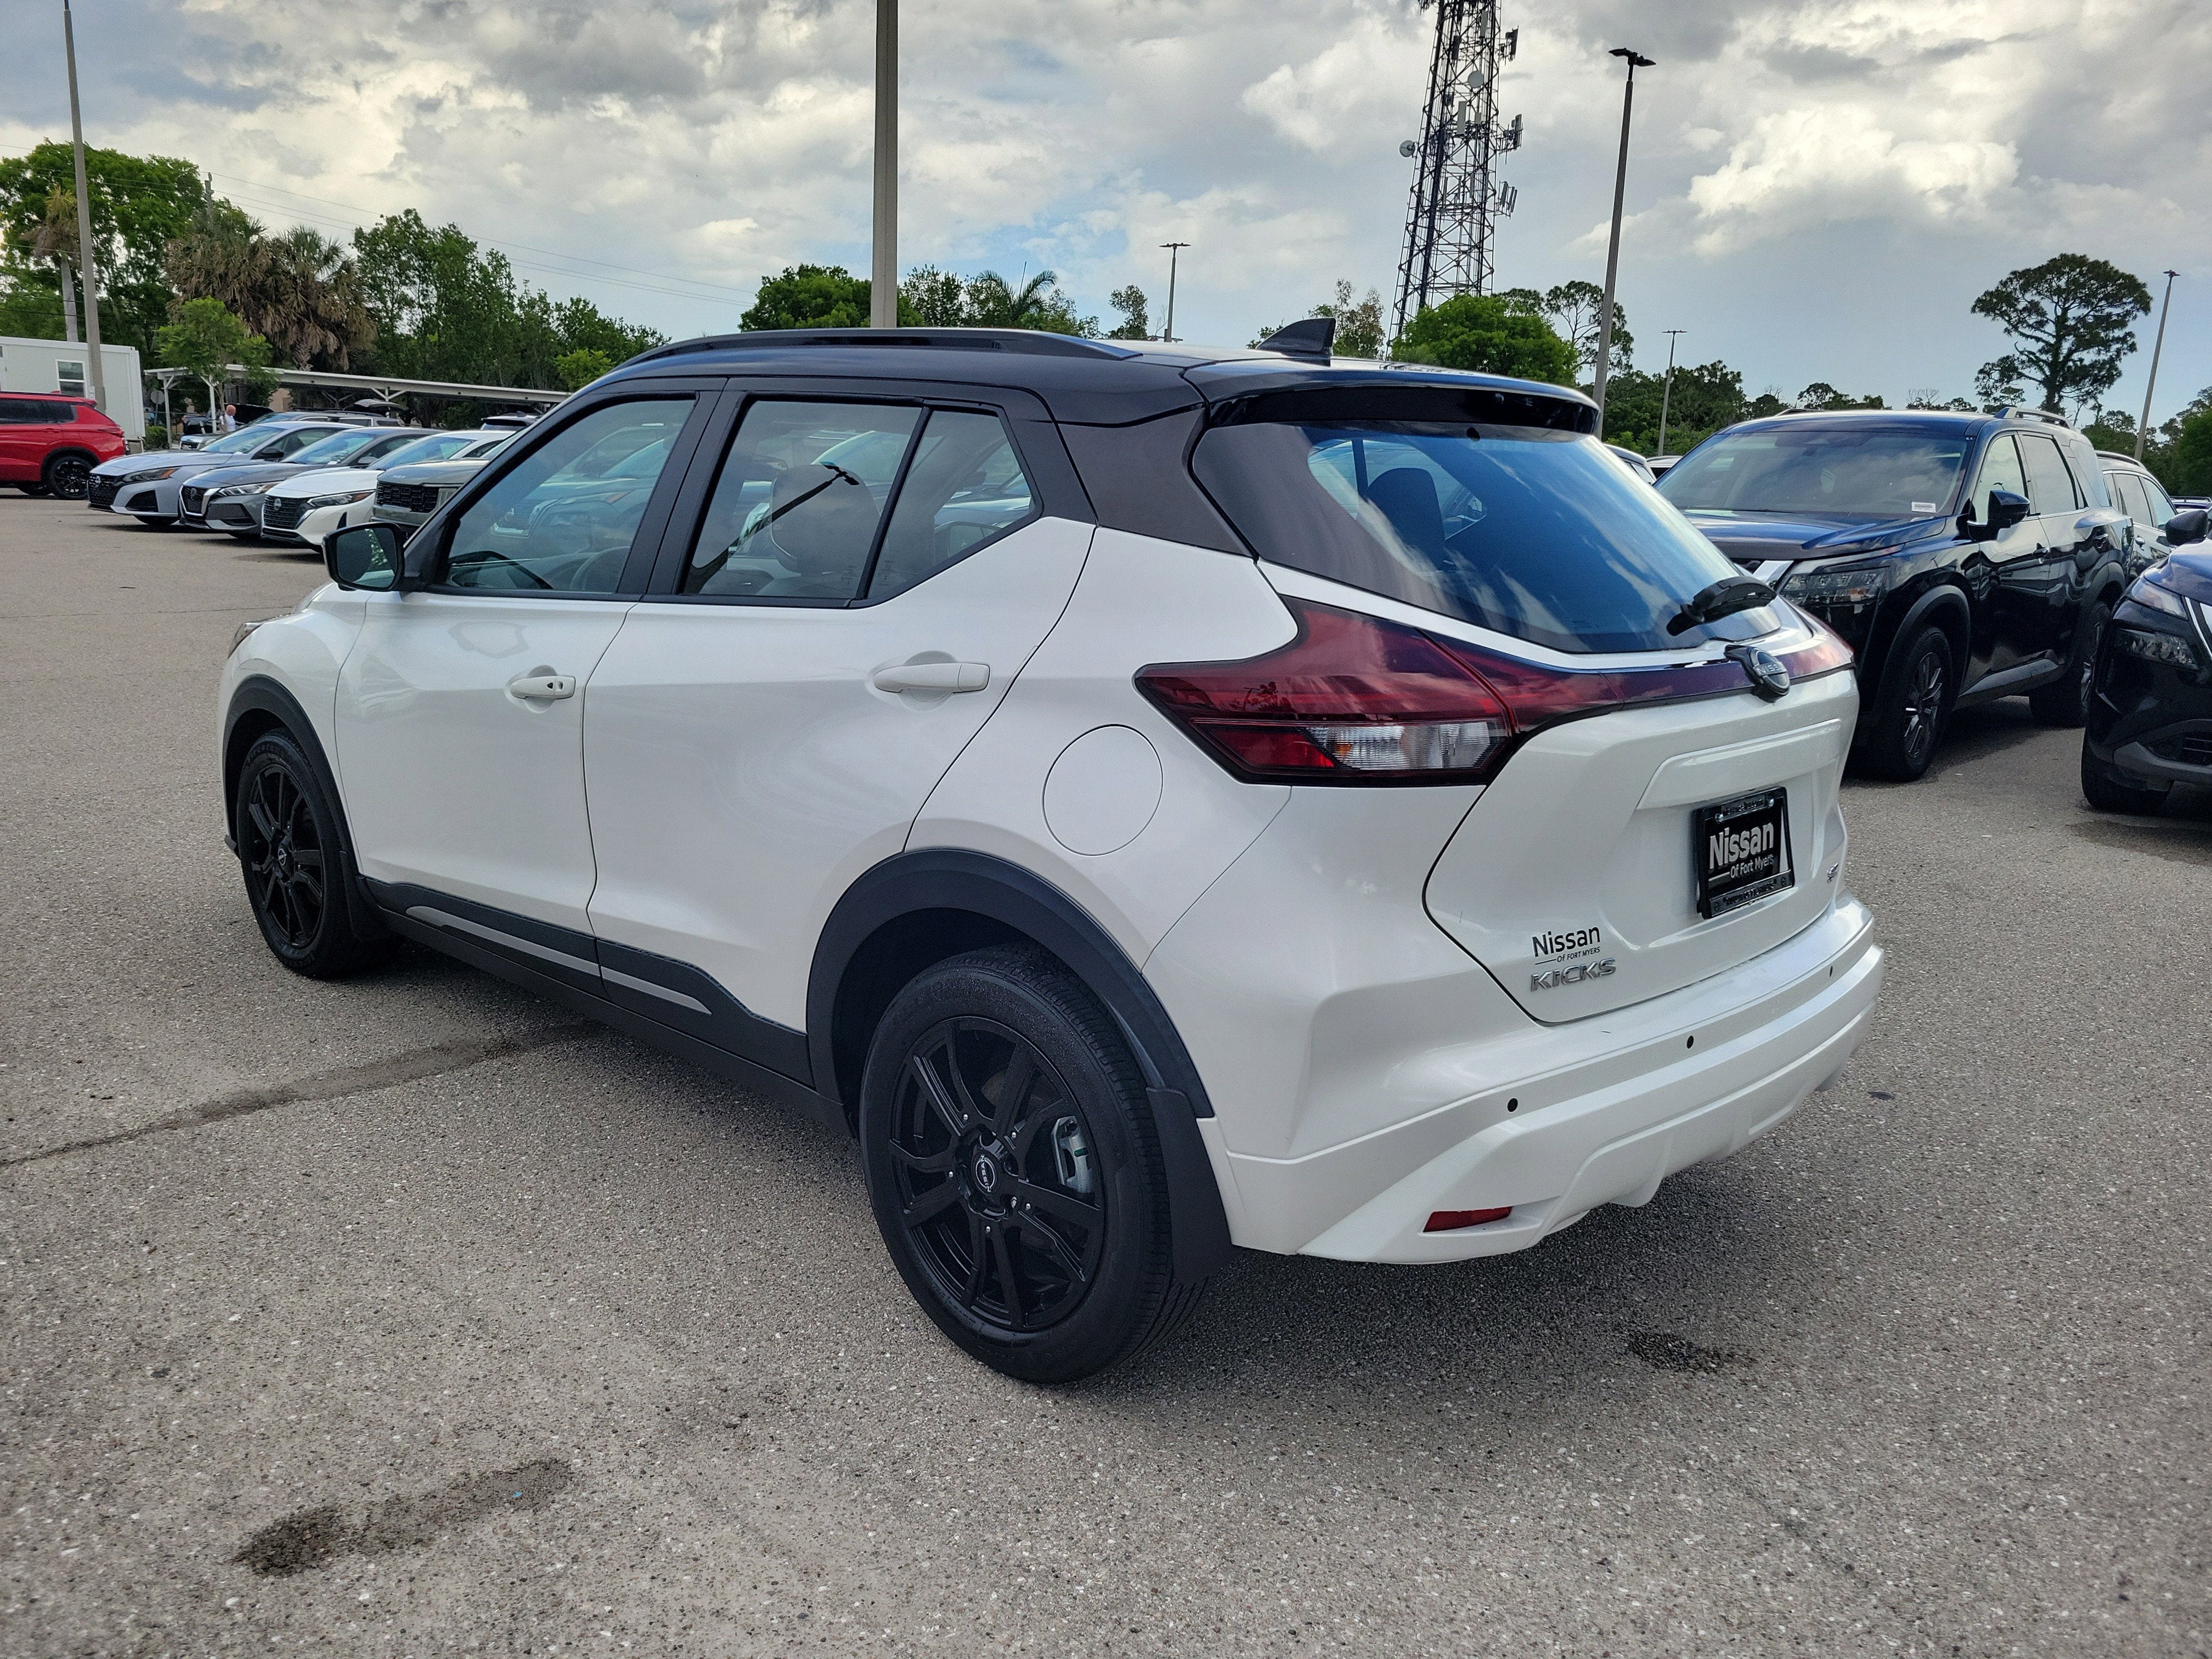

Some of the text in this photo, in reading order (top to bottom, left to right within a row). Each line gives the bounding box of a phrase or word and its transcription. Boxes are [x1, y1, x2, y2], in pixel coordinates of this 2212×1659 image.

[1709, 822, 1774, 869] Nissan
[1730, 854, 1774, 878] Of Fort Myers
[1532, 927, 1600, 957] Nissan
[1567, 951, 1582, 960] FORT
[1582, 946, 1600, 957] MYERS
[1531, 958, 1616, 991] KICKS
[980, 1154, 991, 1192] NISSAN
